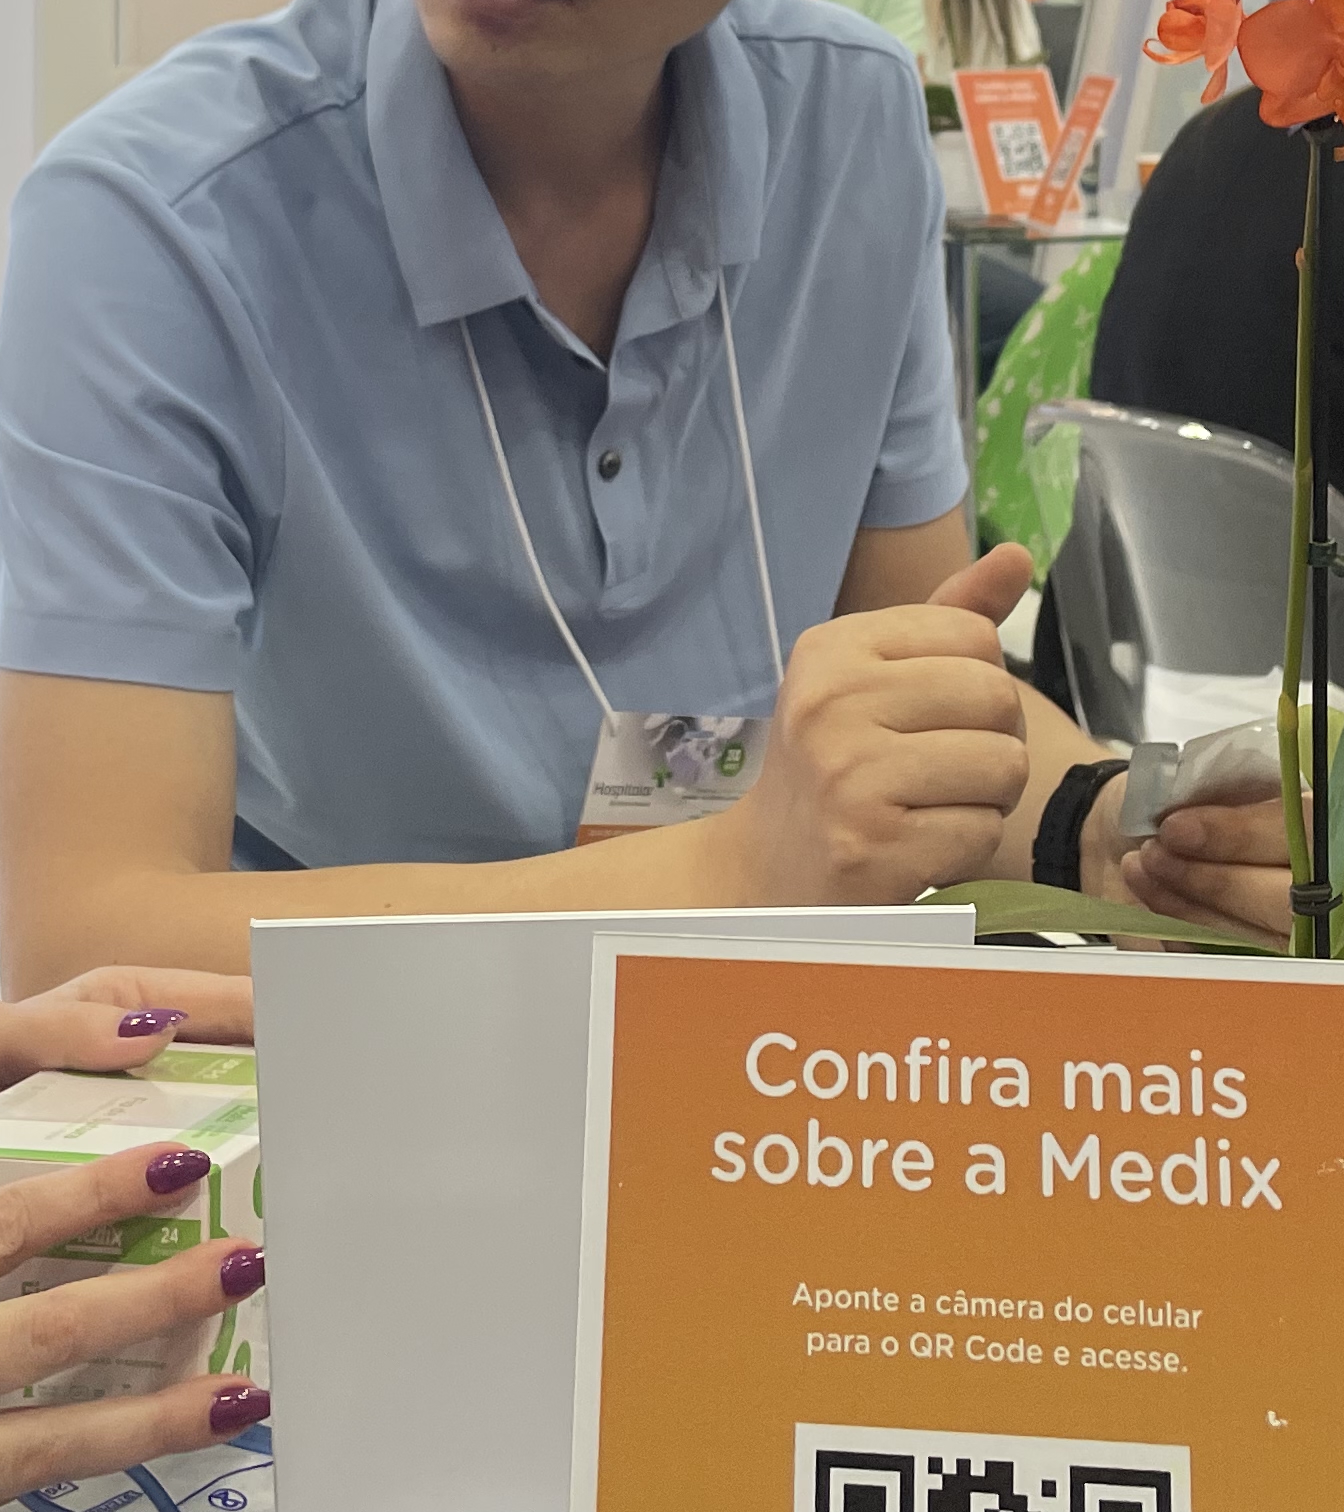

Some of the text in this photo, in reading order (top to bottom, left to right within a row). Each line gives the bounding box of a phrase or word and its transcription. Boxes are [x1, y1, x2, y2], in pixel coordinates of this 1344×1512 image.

[746, 1032, 1248, 1119] Confira mais
[711, 1118, 1283, 1210] sobre a Medix
[160, 1227, 179, 1244] 24
[792, 1282, 1203, 1330] Aponte a câmera do celular
[807, 1330, 1188, 1373] para o QR Code e acesse.
